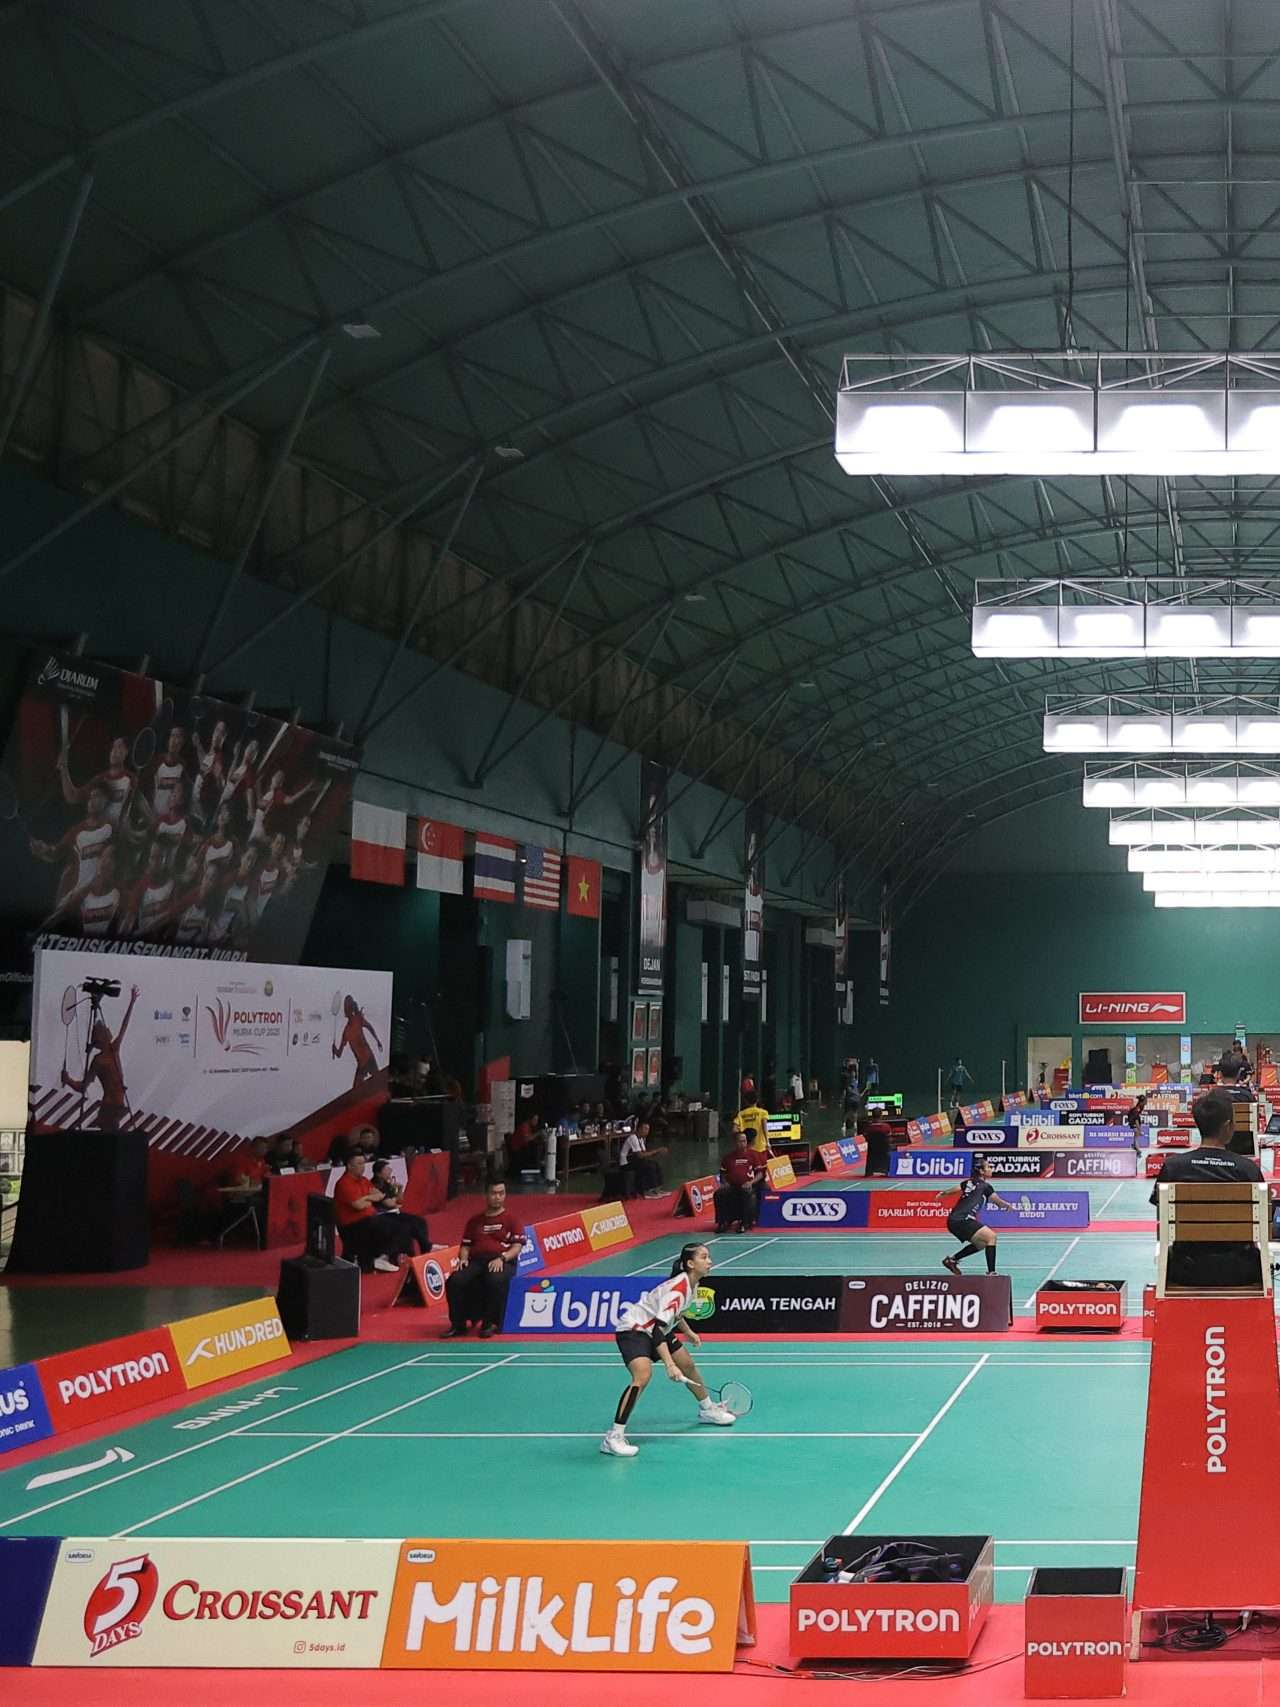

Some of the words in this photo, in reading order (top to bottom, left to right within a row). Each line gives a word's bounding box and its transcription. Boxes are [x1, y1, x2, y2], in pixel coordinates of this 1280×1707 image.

[643, 958, 660, 971] DEJAN
[1085, 1003, 1150, 1013] LI-NING
[233, 1012, 283, 1024] POLYTRON
[1022, 1114, 1055, 1126] blibli
[971, 1133, 1002, 1142] FOX'S
[916, 1157, 964, 1175] blibli
[989, 1163, 1040, 1173] GADJAH
[1067, 1159, 1121, 1175] CAFFINO
[789, 1202, 840, 1216] FOX'S
[878, 1208, 914, 1218] DJARUM
[916, 1208, 953, 1217] foundat
[1038, 1202, 1079, 1211] RAHAYU
[543, 1227, 585, 1252] POLYTRON
[904, 1280, 949, 1292] DELIZIO
[721, 1297, 765, 1311] JAWA
[770, 1296, 836, 1311] TENGAH
[1040, 1303, 1117, 1315] POLYTRON
[870, 1294, 980, 1329] CAFFINO
[214, 1318, 284, 1355] HUNDRED
[58, 1351, 170, 1405] POLYTRON
[1205, 1326, 1227, 1473] POLYTRON
[93, 1555, 148, 1635] 5
[162, 1579, 379, 1621] CROISSANT
[404, 1576, 716, 1656] MilkLife
[797, 1608, 960, 1633] POLYTRON
[93, 1621, 143, 1655] DAYS
[308, 1642, 346, 1652] 5days.id
[1027, 1642, 1123, 1656] POLYTRON
